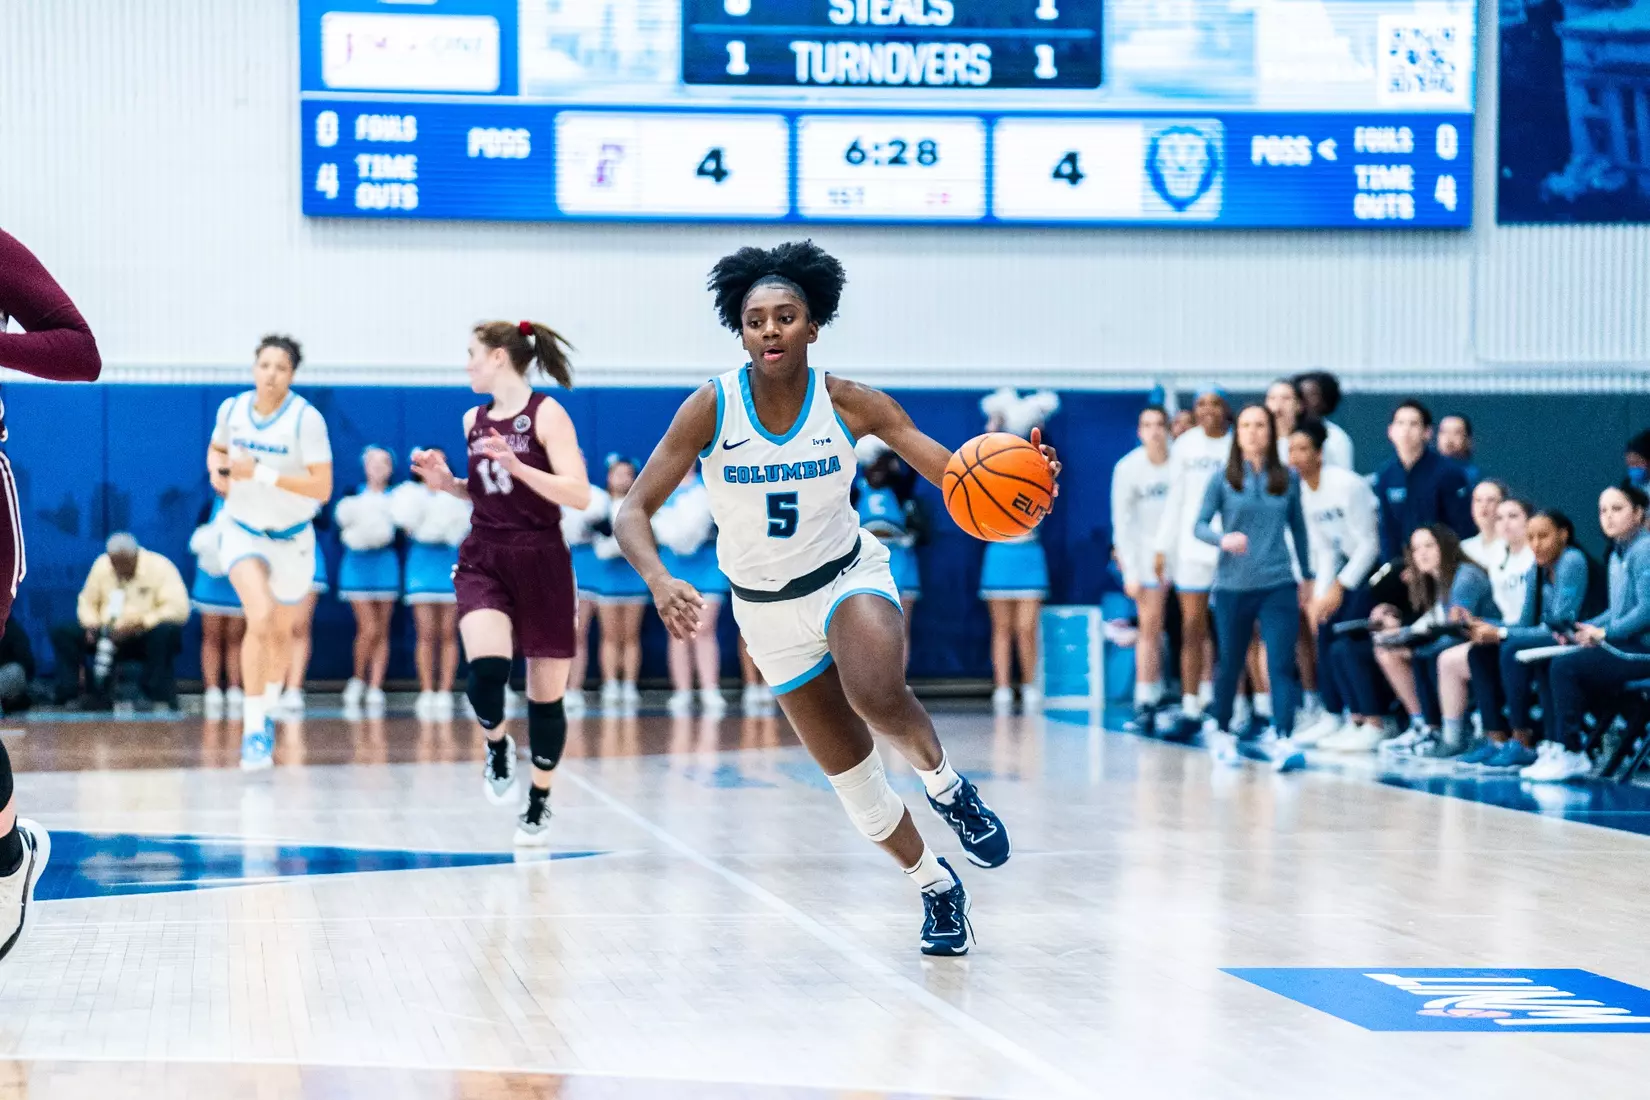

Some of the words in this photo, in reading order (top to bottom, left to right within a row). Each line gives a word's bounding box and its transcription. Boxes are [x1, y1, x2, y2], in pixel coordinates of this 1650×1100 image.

[725, 40, 750, 76] 1
[789, 40, 992, 86] TURNOVERS
[1034, 44, 1058, 79] 1
[315, 110, 339, 147] 0
[354, 113, 418, 142] FOULS
[467, 126, 532, 159] POSS
[1354, 126, 1414, 153] FOULS
[1436, 123, 1458, 160] 0
[354, 153, 418, 181] TIME
[696, 147, 728, 183] 4
[845, 136, 938, 166] 6:28
[1251, 135, 1312, 166] POSS
[315, 162, 339, 199] 4
[1052, 151, 1084, 186] 4
[1354, 164, 1415, 191] TIME
[354, 182, 419, 210] OUTS
[1354, 192, 1415, 219] OUTS
[1434, 174, 1458, 212] 4
[723, 455, 841, 484] COLUMBIA
[765, 491, 799, 538] 5
